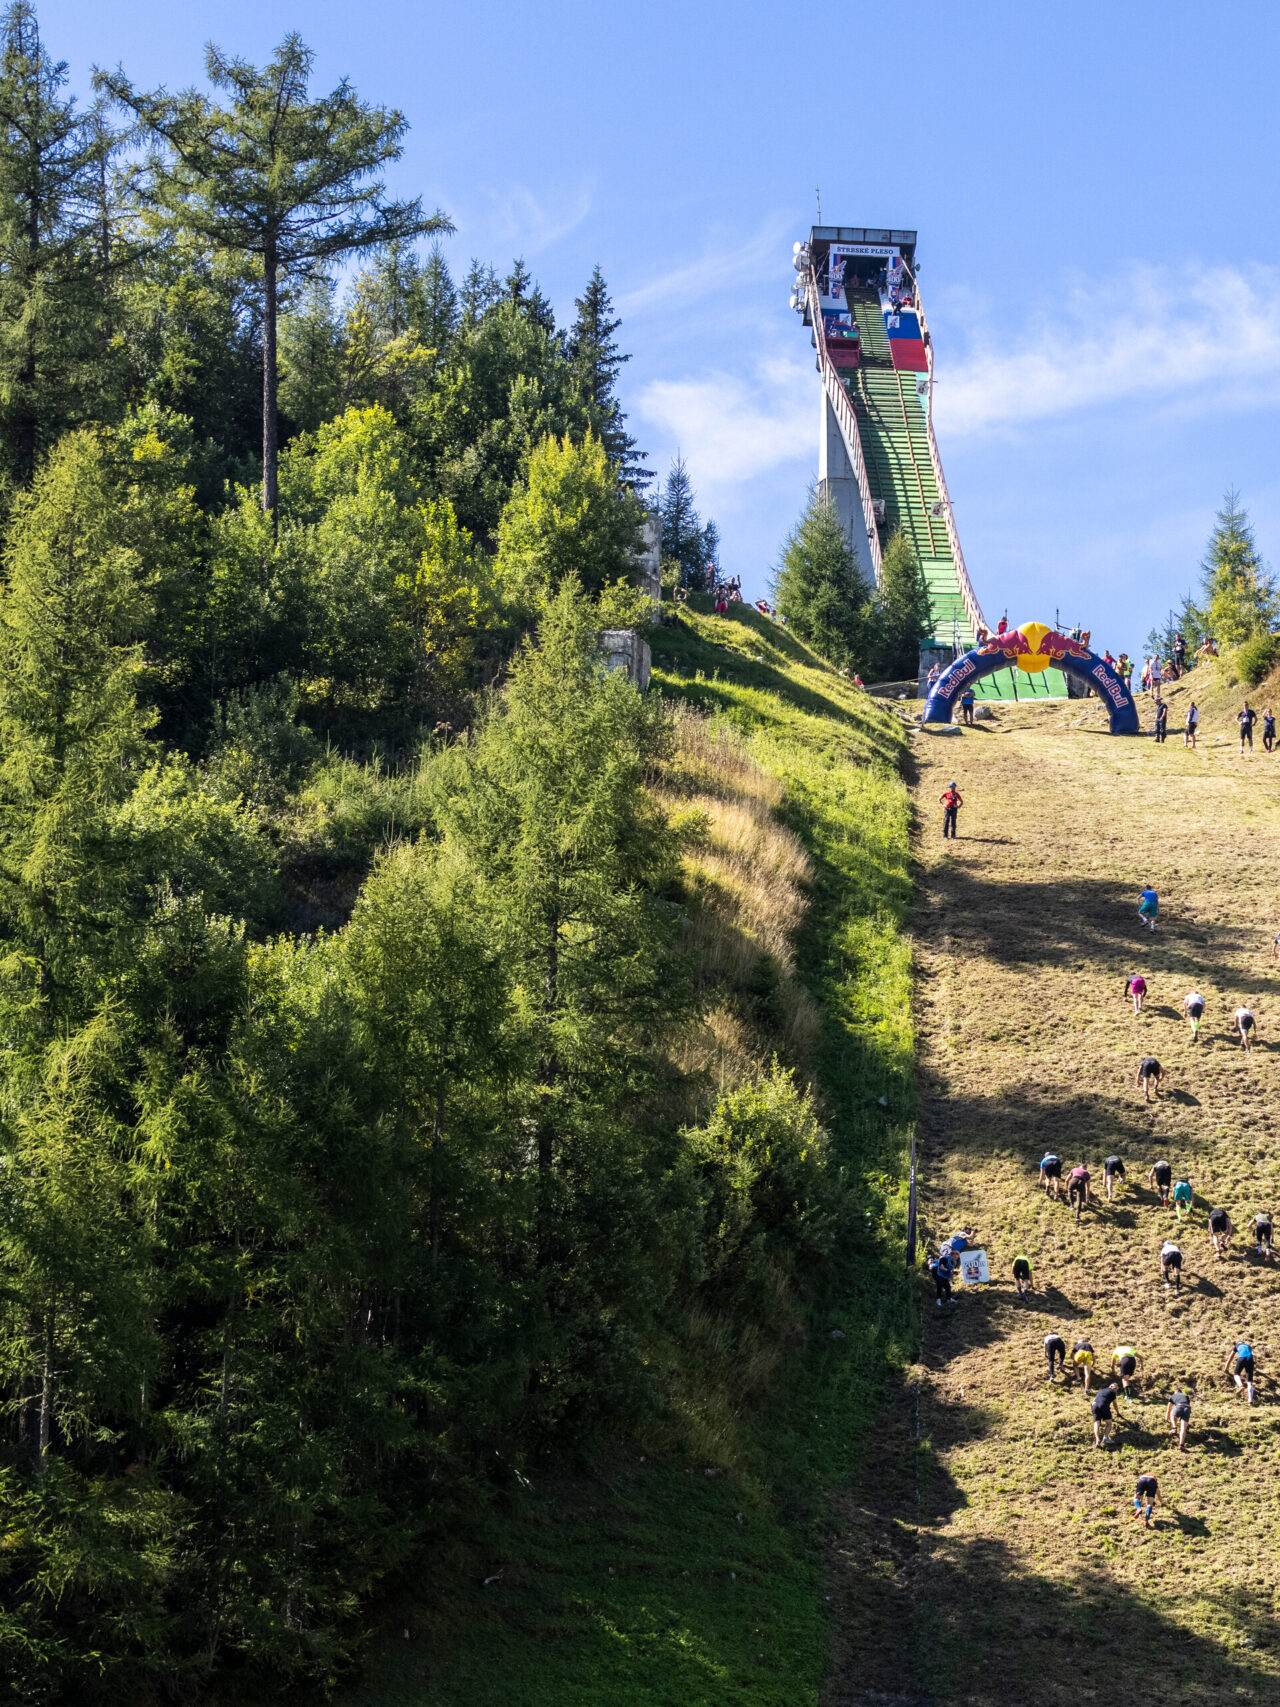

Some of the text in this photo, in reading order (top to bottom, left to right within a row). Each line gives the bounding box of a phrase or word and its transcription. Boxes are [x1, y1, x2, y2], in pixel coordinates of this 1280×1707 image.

[938, 658, 976, 699] Red Bull
[1092, 664, 1129, 709] Red Bull
